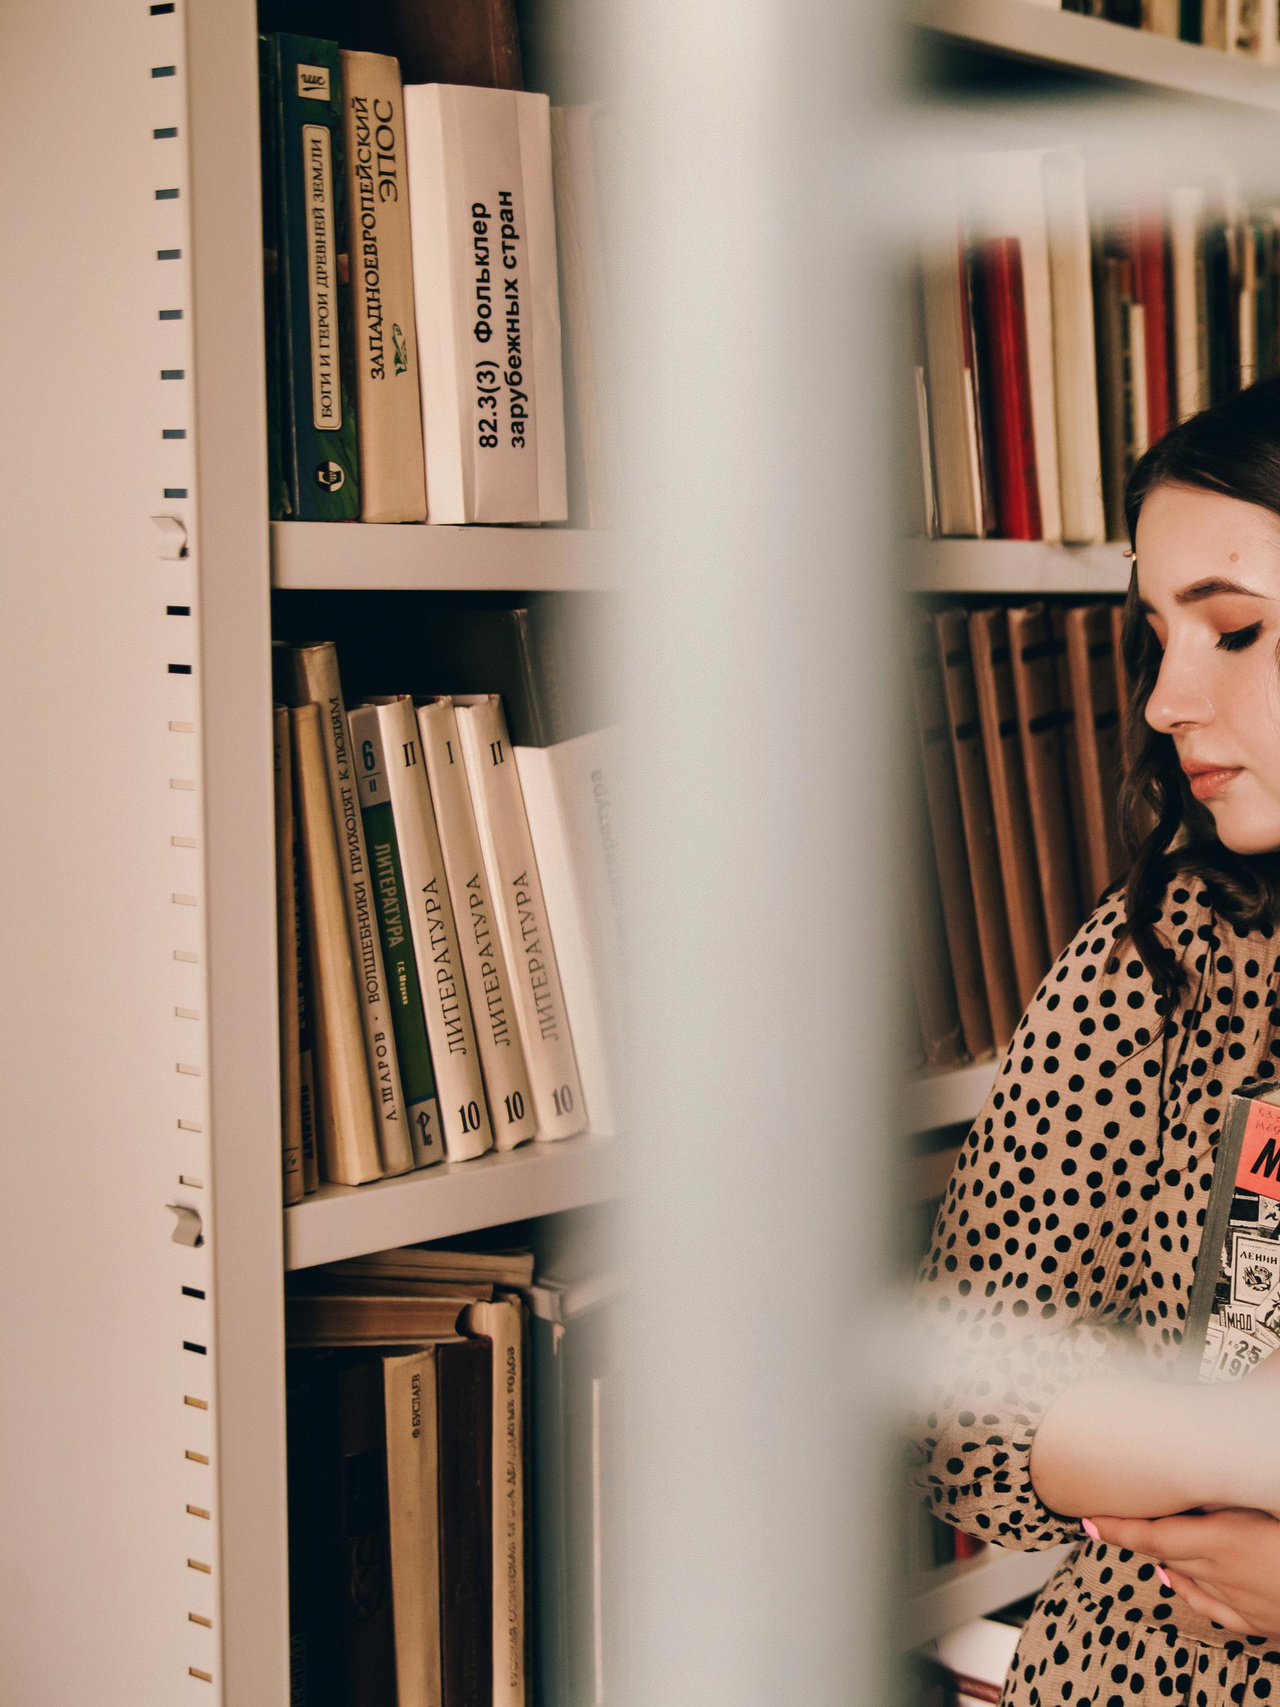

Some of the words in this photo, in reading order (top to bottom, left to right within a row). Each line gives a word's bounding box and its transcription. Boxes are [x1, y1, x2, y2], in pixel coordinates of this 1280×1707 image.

[311, 139, 325, 203] ЗЕМЛИ
[373, 99, 398, 203] ЭПОС
[312, 207, 329, 288] ДРЕВНЕЙ
[352, 96, 385, 380] ЗАПАДНОЕВРОПЕЙСКИЙ
[498, 191, 520, 269] стран
[471, 202, 493, 343] Фольклер
[317, 293, 330, 349] ГЕРОИ
[319, 354, 331, 367] И
[320, 372, 333, 419] БОГИ
[503, 278, 529, 449] зарубежных
[475, 360, 501, 448] 82.3(3)
[329, 697, 348, 765] ЛЮДЯМ
[361, 739, 376, 771] 6
[339, 768, 350, 781] К
[341, 787, 363, 874] ПРИХОДЯТ
[374, 843, 405, 948] ЛИТЕРАТУРА
[353, 880, 380, 1004] ВОЛШЕБНИКИ
[421, 876, 467, 1055] ЛИТЕРАТУРА
[466, 872, 510, 1047] ЛИТЕРАТУРА
[512, 870, 559, 1042] ЛИТЕРАТУРА
[458, 1100, 481, 1134] 10
[504, 1090, 525, 1124] 10
[551, 1083, 574, 1118] 10
[1239, 1250, 1278, 1265] ЛЕНИН
[1219, 1352, 1251, 1377] 191
[1235, 1340, 1262, 1365] 25
